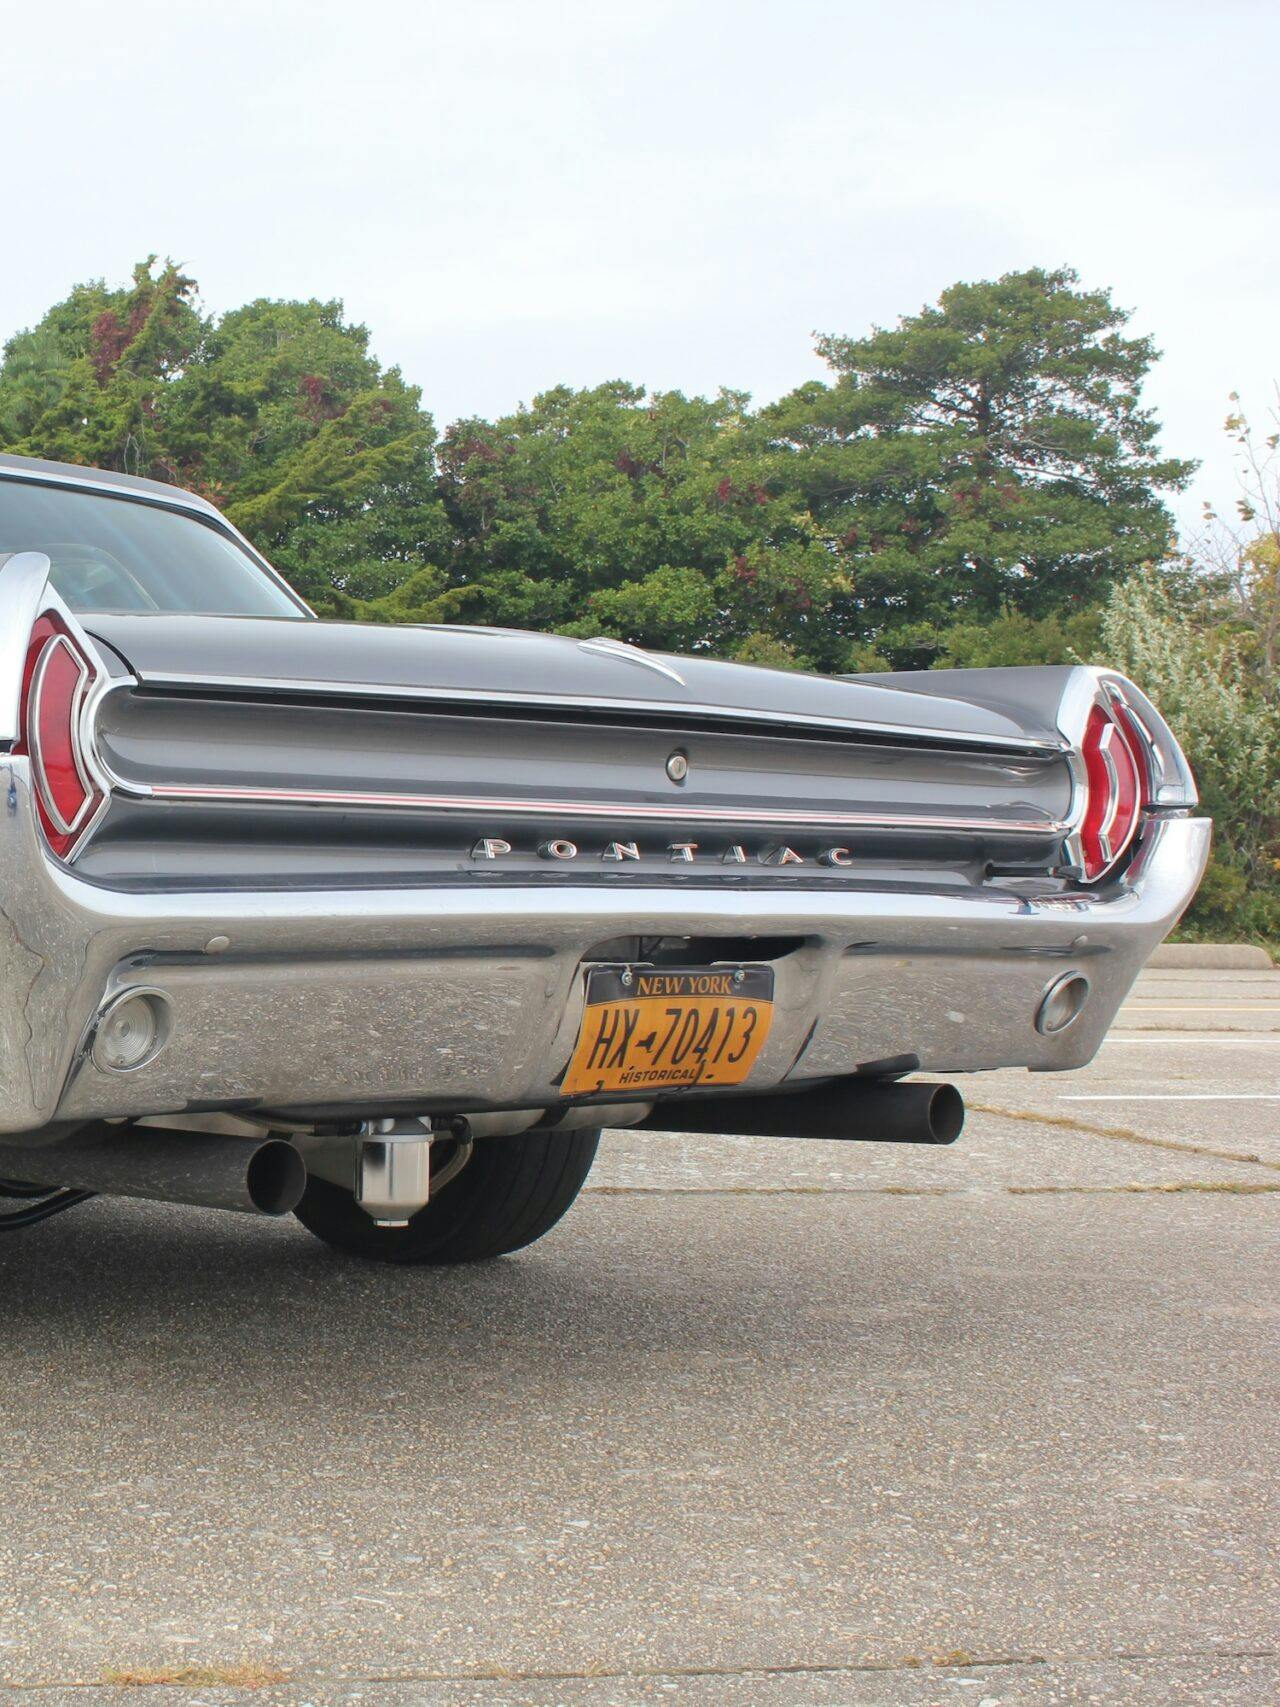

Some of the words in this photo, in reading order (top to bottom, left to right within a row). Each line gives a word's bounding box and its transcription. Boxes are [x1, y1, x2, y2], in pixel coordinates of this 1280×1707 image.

[470, 837, 853, 867] PONTIAC
[637, 977, 684, 996] NEW
[688, 976, 732, 995] YORK
[620, 1069, 696, 1084] HISTORICAL
